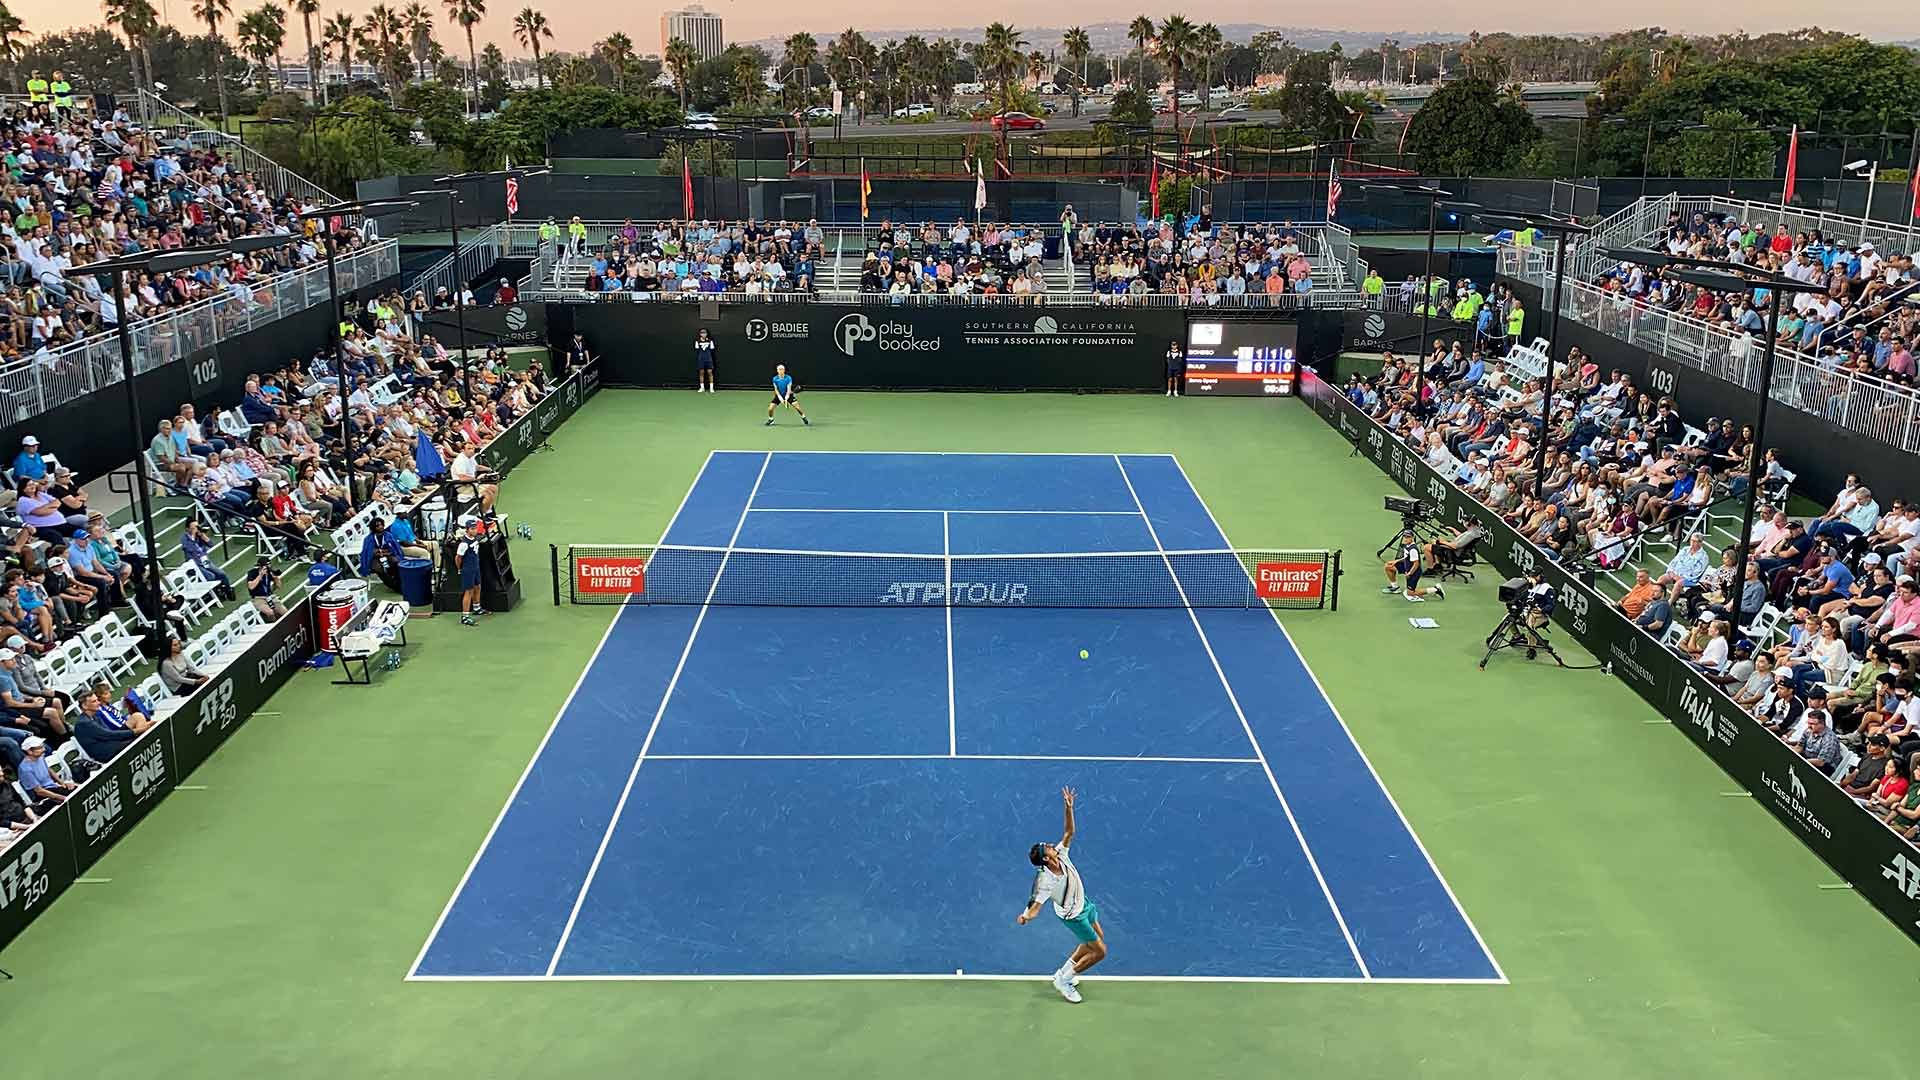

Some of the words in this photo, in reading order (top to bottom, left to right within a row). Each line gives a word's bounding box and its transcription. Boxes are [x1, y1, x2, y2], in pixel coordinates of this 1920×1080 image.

[772, 323, 808, 333] BADIEE
[879, 320, 913, 338] play
[965, 322, 1029, 330] SOUTHERN
[879, 337, 941, 351] booked
[193, 358, 217, 385] 102
[1651, 367, 1673, 394] 103
[1367, 428, 1384, 448] ATP
[1427, 477, 1447, 501] ATP
[1508, 541, 1535, 572] ATP
[581, 564, 642, 577] Emirates
[591, 577, 604, 588] FLY
[605, 577, 632, 588] BETTER
[1261, 568, 1321, 581] Emirates
[879, 582, 945, 603] ATP
[950, 582, 1029, 603] TOUR
[1268, 582, 1282, 592] FLY
[1282, 582, 1310, 592] BETTER
[1557, 582, 1589, 617] ATP
[1572, 616, 1587, 635] 250
[257, 623, 307, 684] DermTech
[193, 677, 234, 736] ATP
[220, 703, 237, 730] 250
[129, 738, 162, 773] TENNIS
[131, 752, 165, 796] ONE
[82, 775, 119, 814] TENNIS
[145, 784, 158, 799] APP
[85, 788, 122, 836] ONE
[1761, 770, 1771, 787] La
[1771, 780, 1791, 804] Casa
[1791, 797, 1806, 818] Del
[1806, 810, 1832, 839] Zorro
[100, 824, 114, 840] APP
[23, 873, 49, 911] 250
